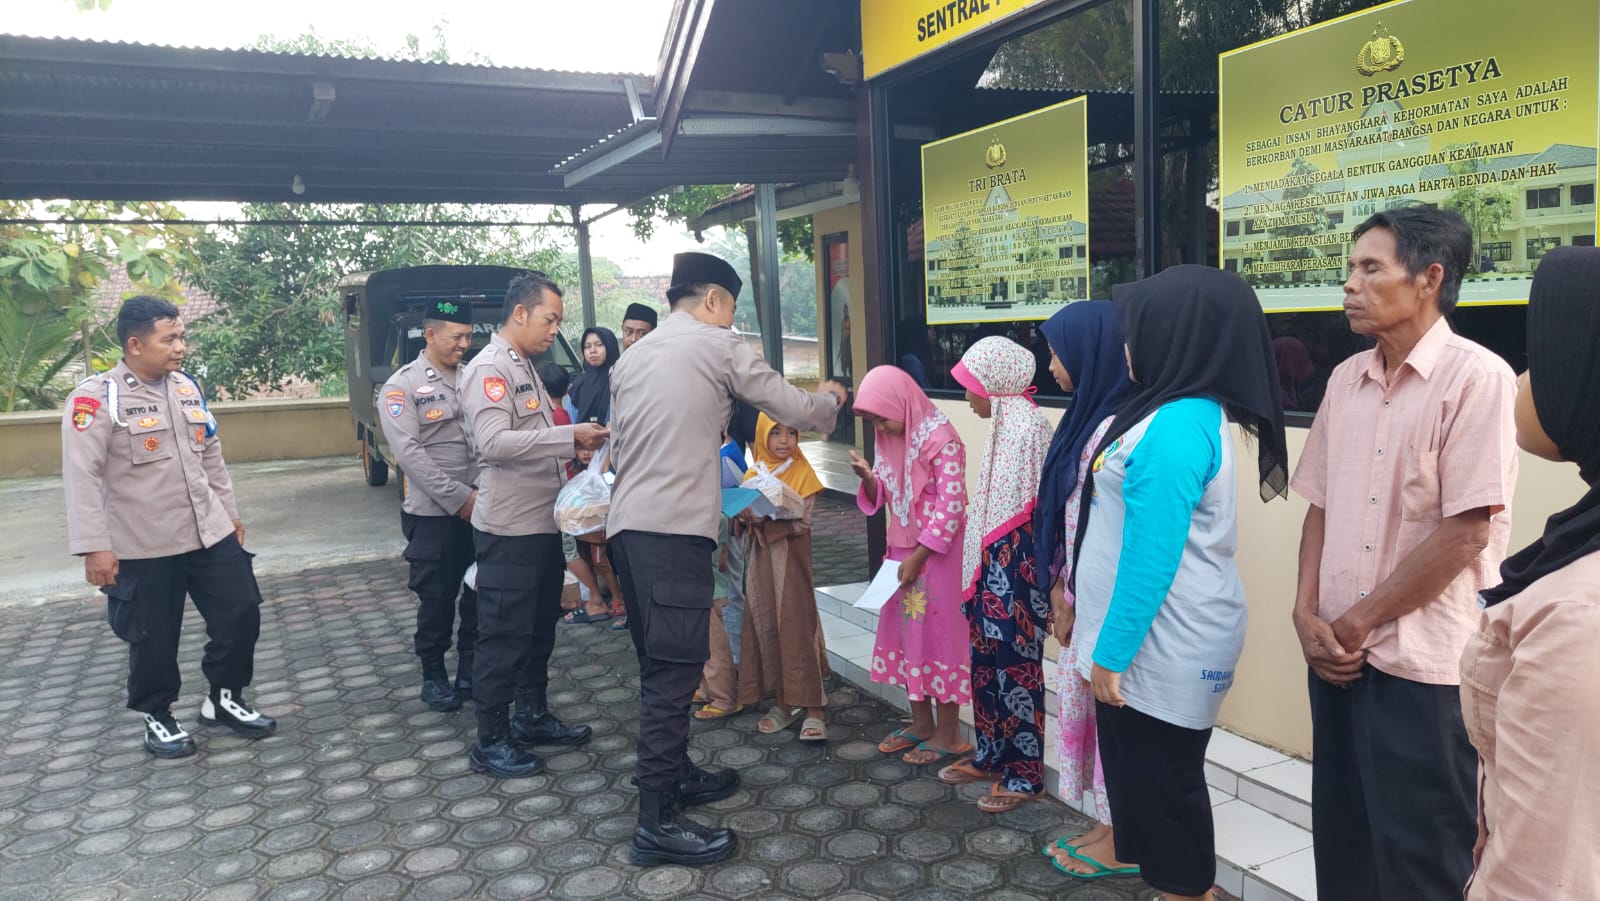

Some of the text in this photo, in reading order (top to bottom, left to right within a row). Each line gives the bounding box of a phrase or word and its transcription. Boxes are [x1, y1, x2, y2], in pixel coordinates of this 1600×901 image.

[1246, 77, 1568, 152] SEBAGAI INSAN BHAYANGKARA KEHORMATAN SAYA ADALAH
[1279, 57, 1502, 124] CATUR PRASETYA
[1246, 149, 1296, 167] BERKORBAN
[1299, 143, 1321, 157] DEMI
[1324, 131, 1388, 152] MASYARAKAT
[1391, 123, 1433, 141] BANGSA
[1436, 117, 1459, 132] DAN
[1463, 108, 1511, 127] NEGARA
[1515, 98, 1560, 117] UNTUK
[968, 168, 1027, 193] TRI BRATA
[1244, 163, 1557, 216] 2. MENJAGA KESELAMATAN JIWA RAGA HARTA BENDA DAN HAK
[1252, 174, 1308, 193] MENIADAKAN
[1309, 169, 1345, 184] SEGALA
[1346, 161, 1386, 178] BENTUK
[1388, 153, 1446, 171] GANGGUAN
[1449, 140, 1514, 161] KEAMANAN
[1253, 237, 1292, 252] MENJAMIN
[1293, 232, 1337, 247] KEPASTIAN
[1276, 213, 1316, 227] MANUSIA
[1253, 259, 1301, 273] MEMELIHARA
[1302, 256, 1342, 270] PERASAAN
